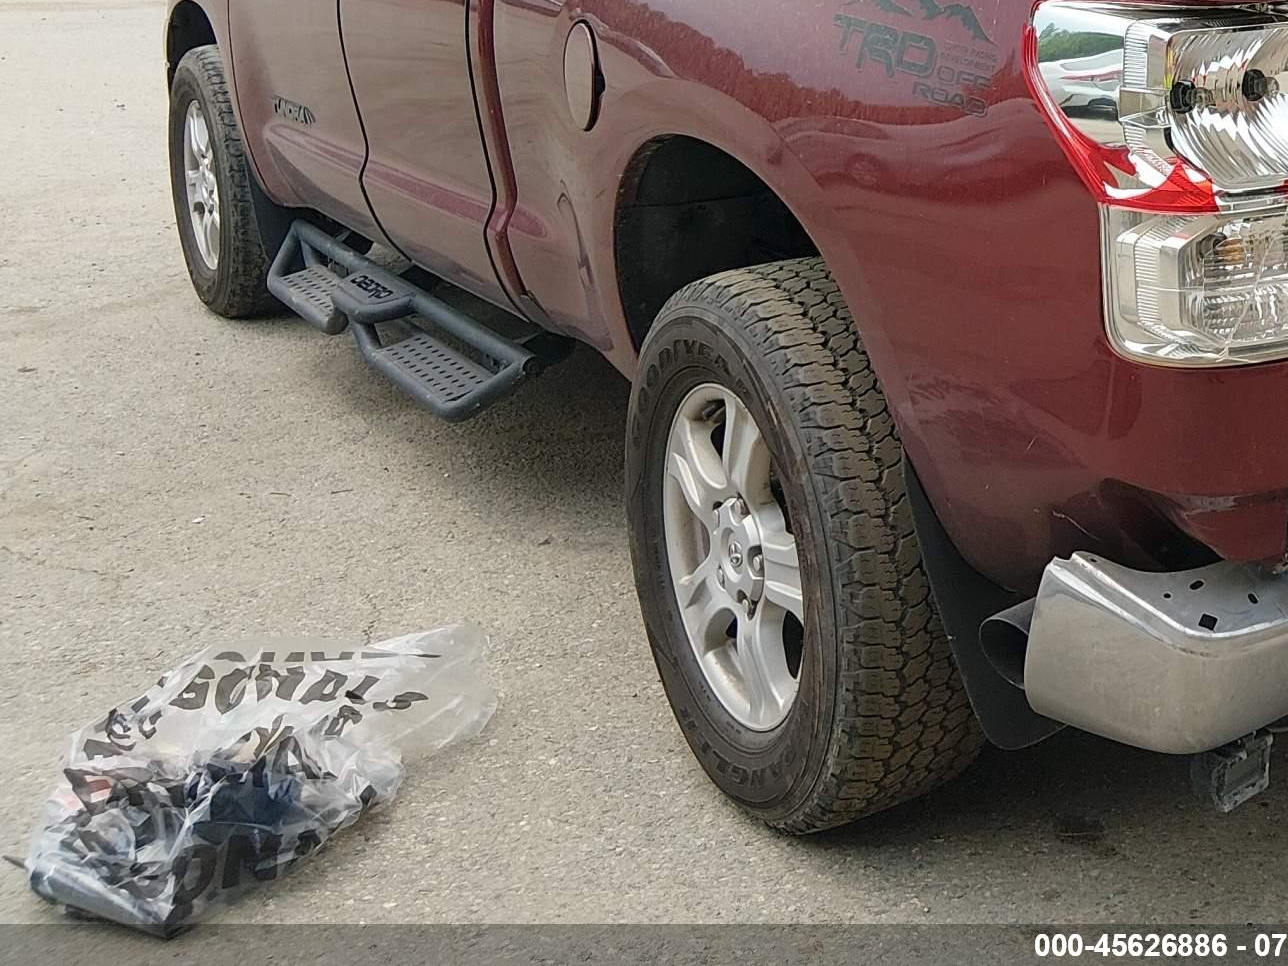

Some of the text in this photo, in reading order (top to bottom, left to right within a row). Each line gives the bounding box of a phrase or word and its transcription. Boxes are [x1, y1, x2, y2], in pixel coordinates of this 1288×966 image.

[832, 13, 938, 79] TRD
[937, 65, 992, 90] OFF
[911, 81, 988, 117] ROAD
